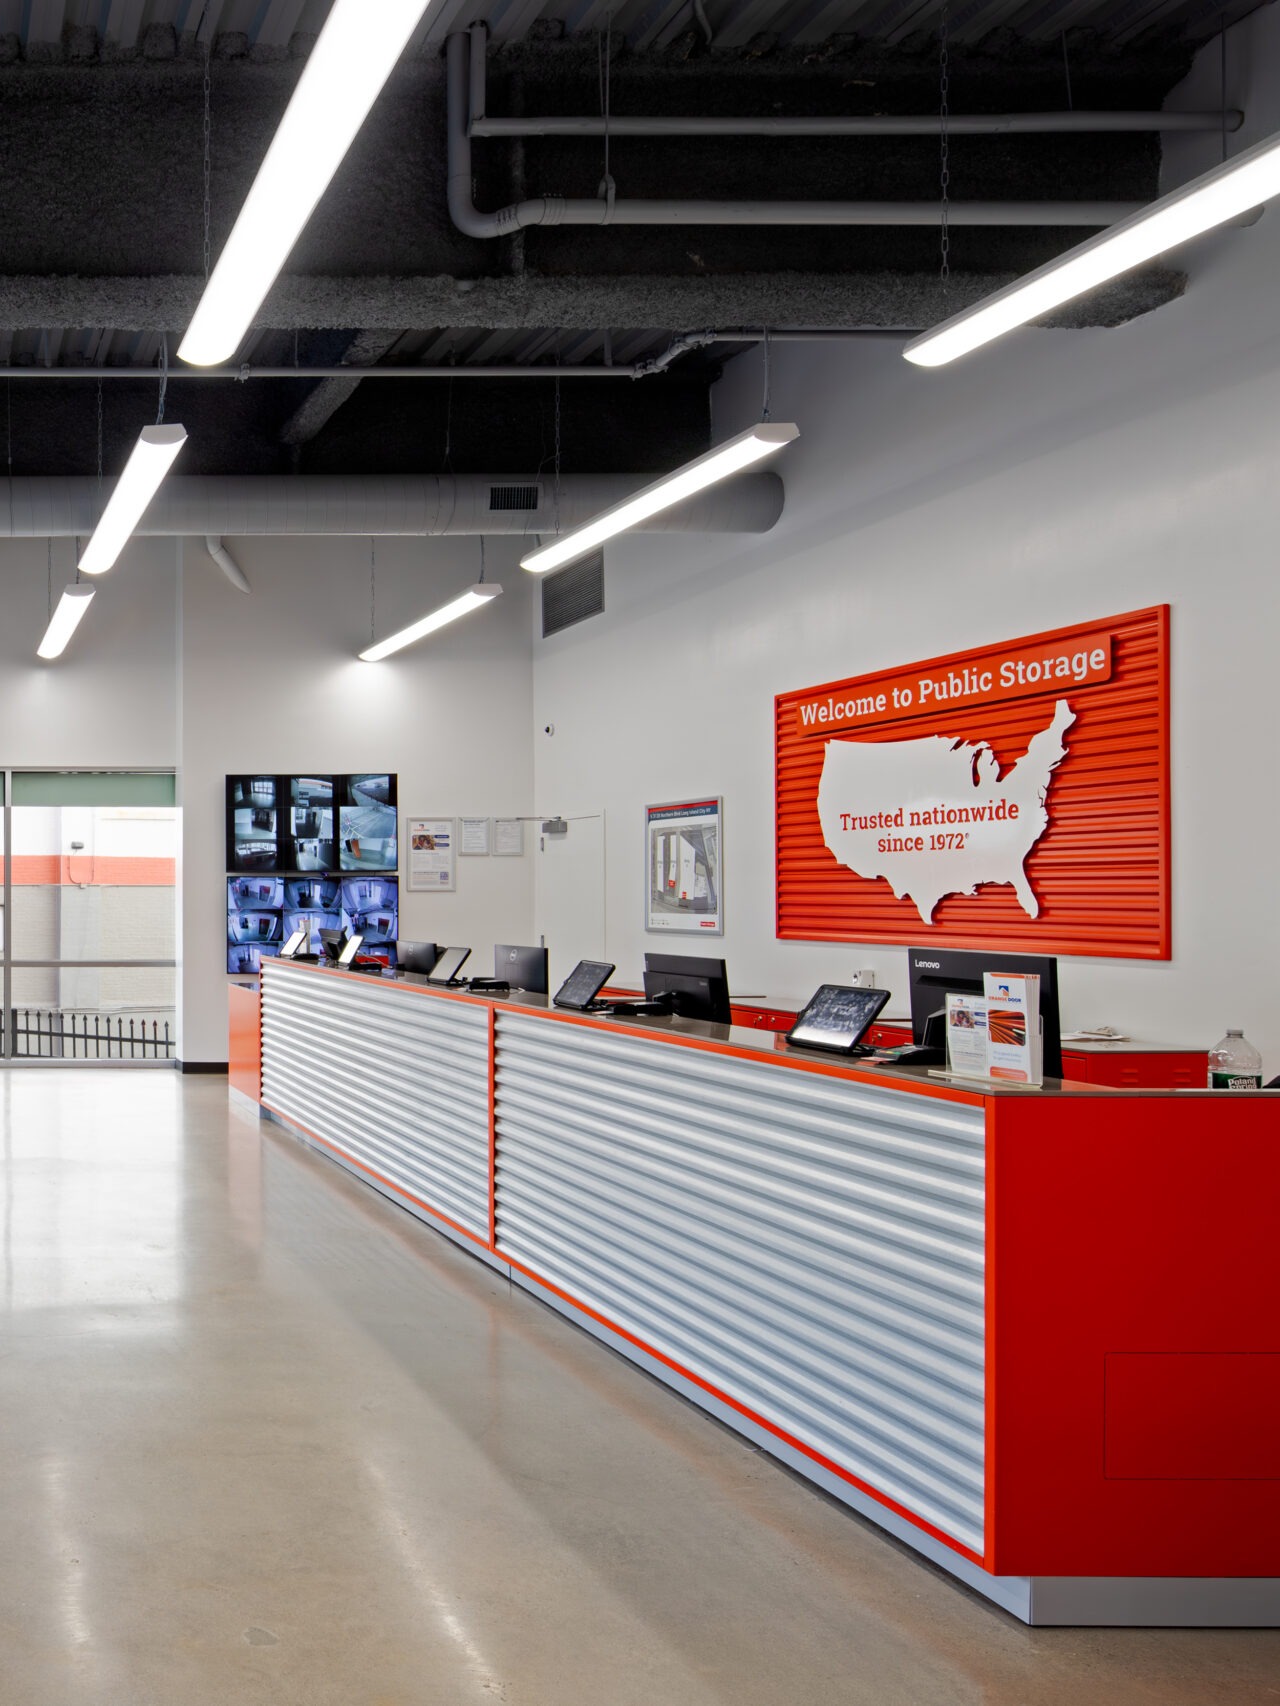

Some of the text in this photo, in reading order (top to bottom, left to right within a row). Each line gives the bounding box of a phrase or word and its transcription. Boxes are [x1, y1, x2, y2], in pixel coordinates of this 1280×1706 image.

[800, 648, 1105, 726] Welcome to Public Storage
[840, 798, 1019, 831] Trusted nationwide
[878, 834, 924, 852] since
[914, 959, 940, 968] Lenovo
[1228, 1077, 1256, 1086] Poland
